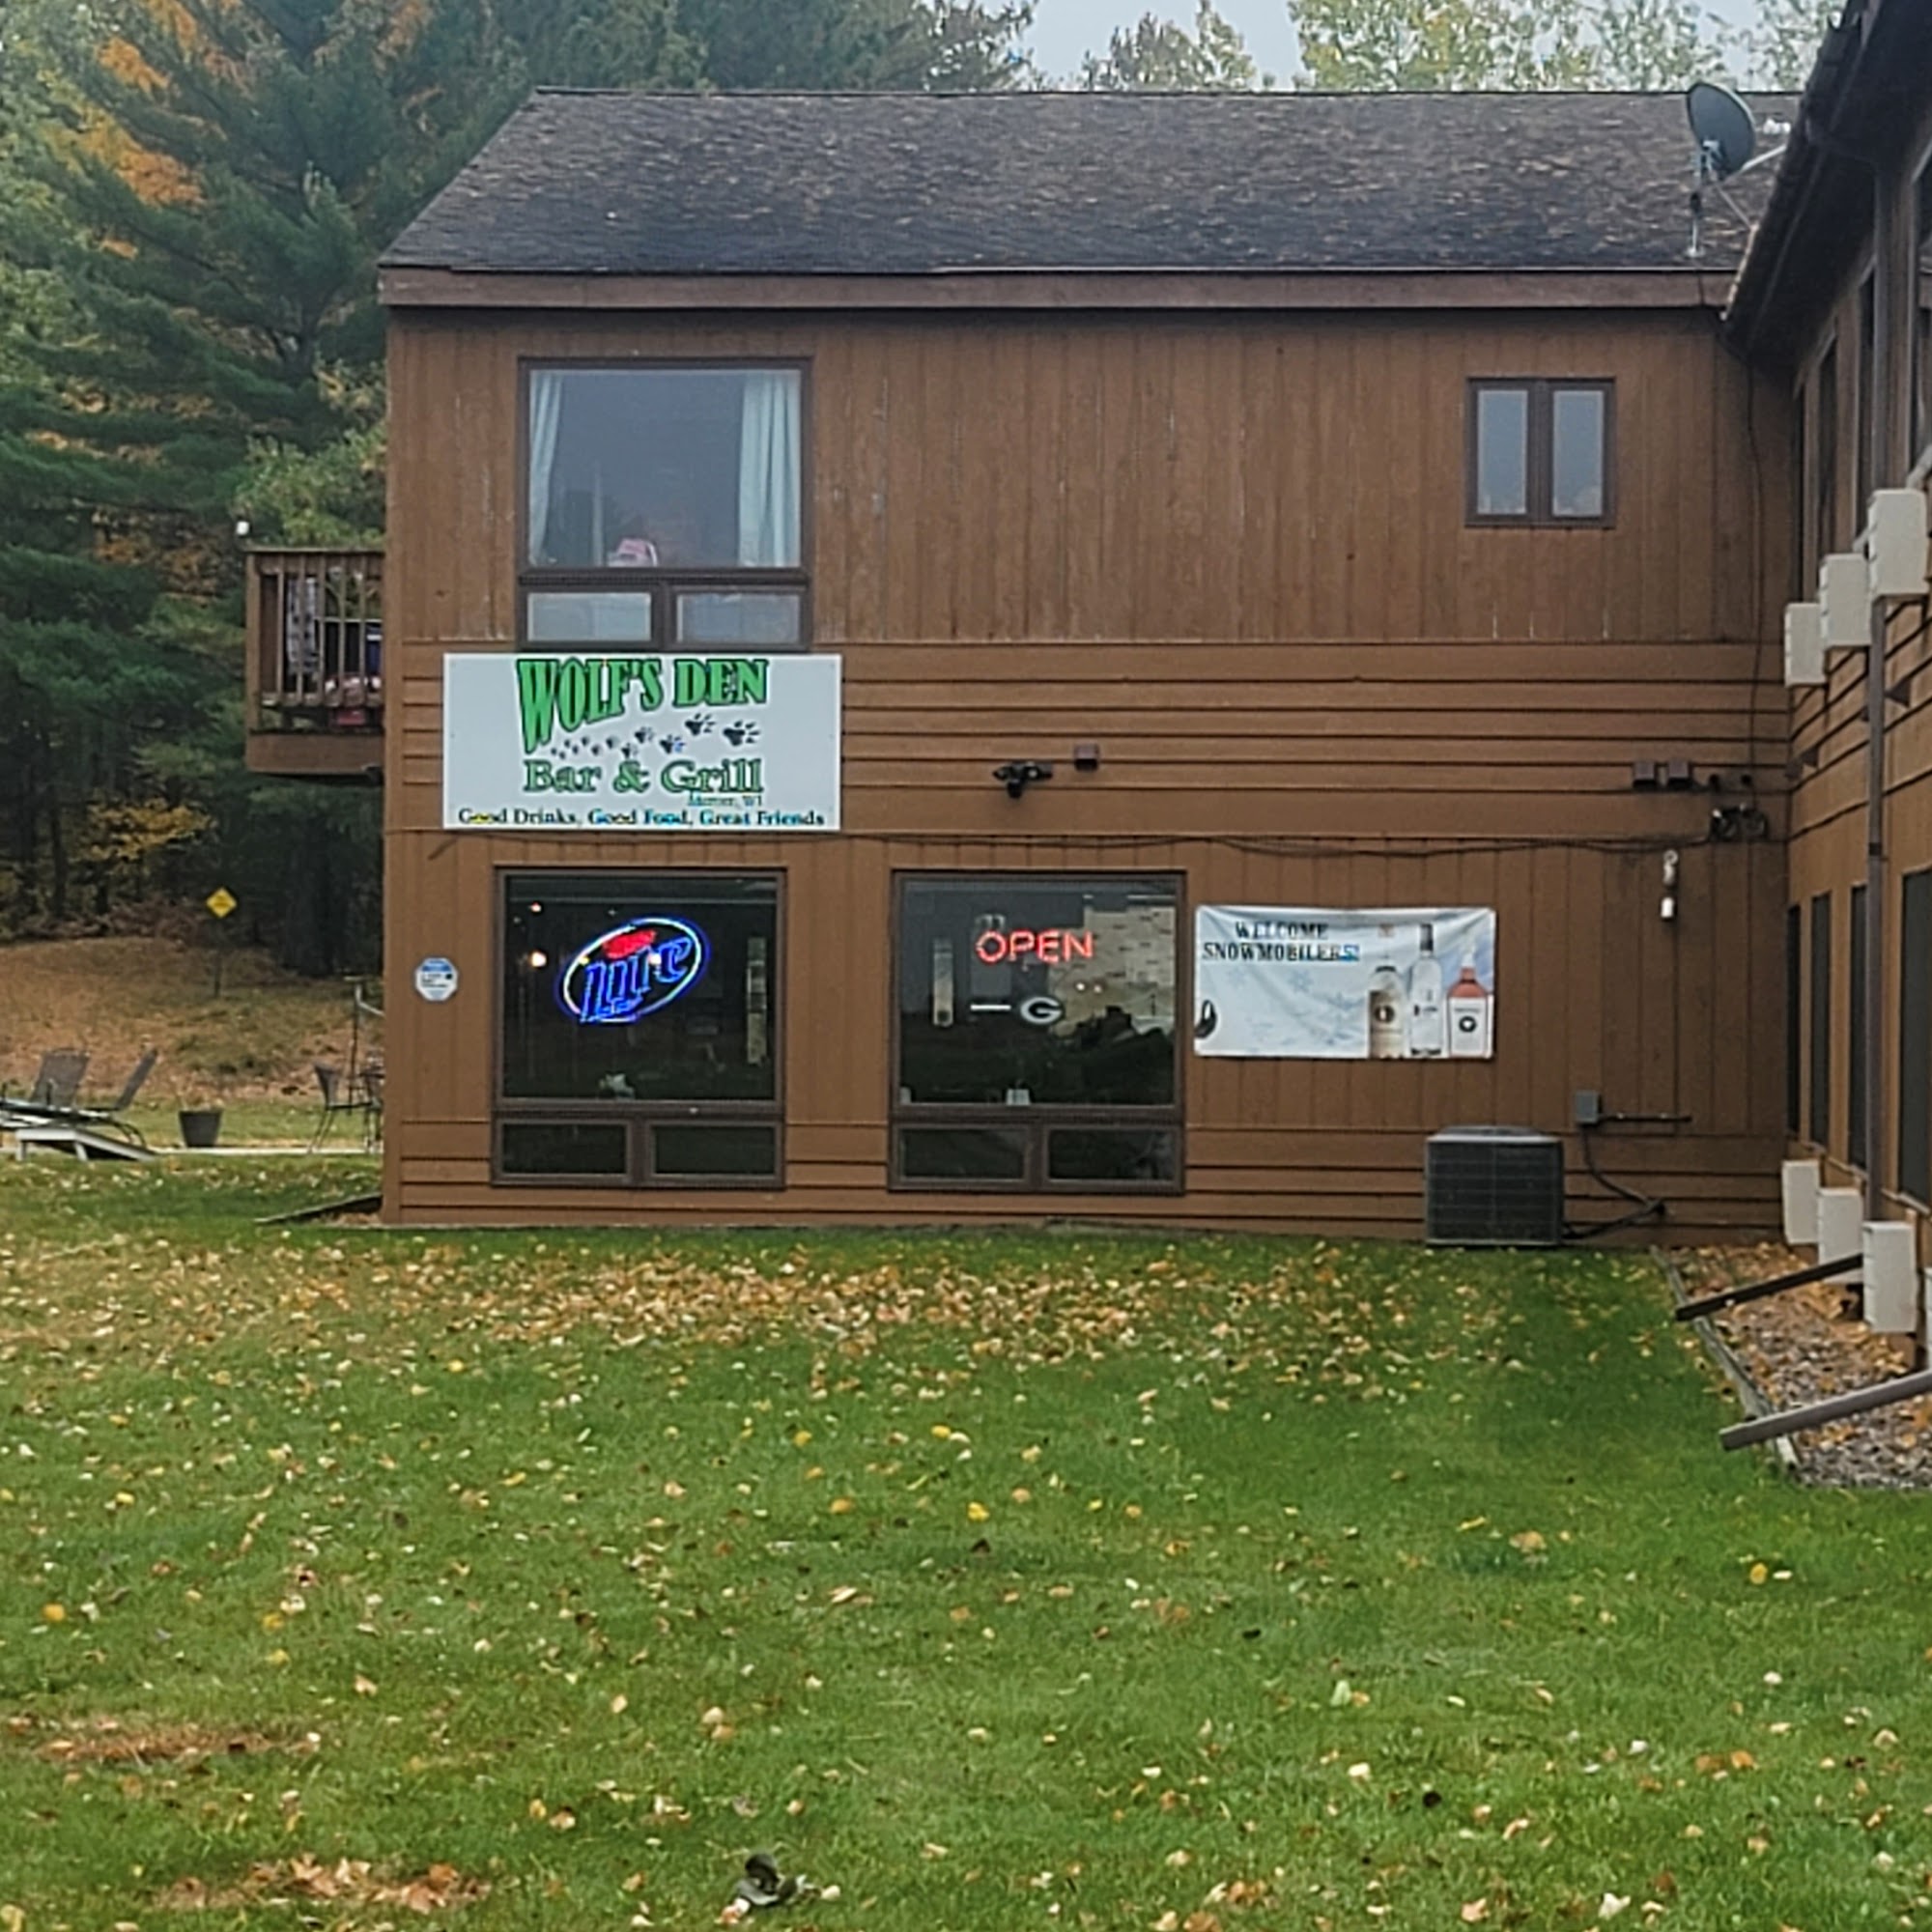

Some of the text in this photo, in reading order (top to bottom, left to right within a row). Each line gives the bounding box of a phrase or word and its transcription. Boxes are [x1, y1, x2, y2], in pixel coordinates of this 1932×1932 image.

[516, 658, 770, 753] WOLF'S DEN
[523, 758, 764, 795] Bar & Grill
[459, 808, 825, 828] Good Drinks, Good Food, Great Friends
[975, 927, 1096, 964] OPEN
[1236, 921, 1329, 940] WELCOME
